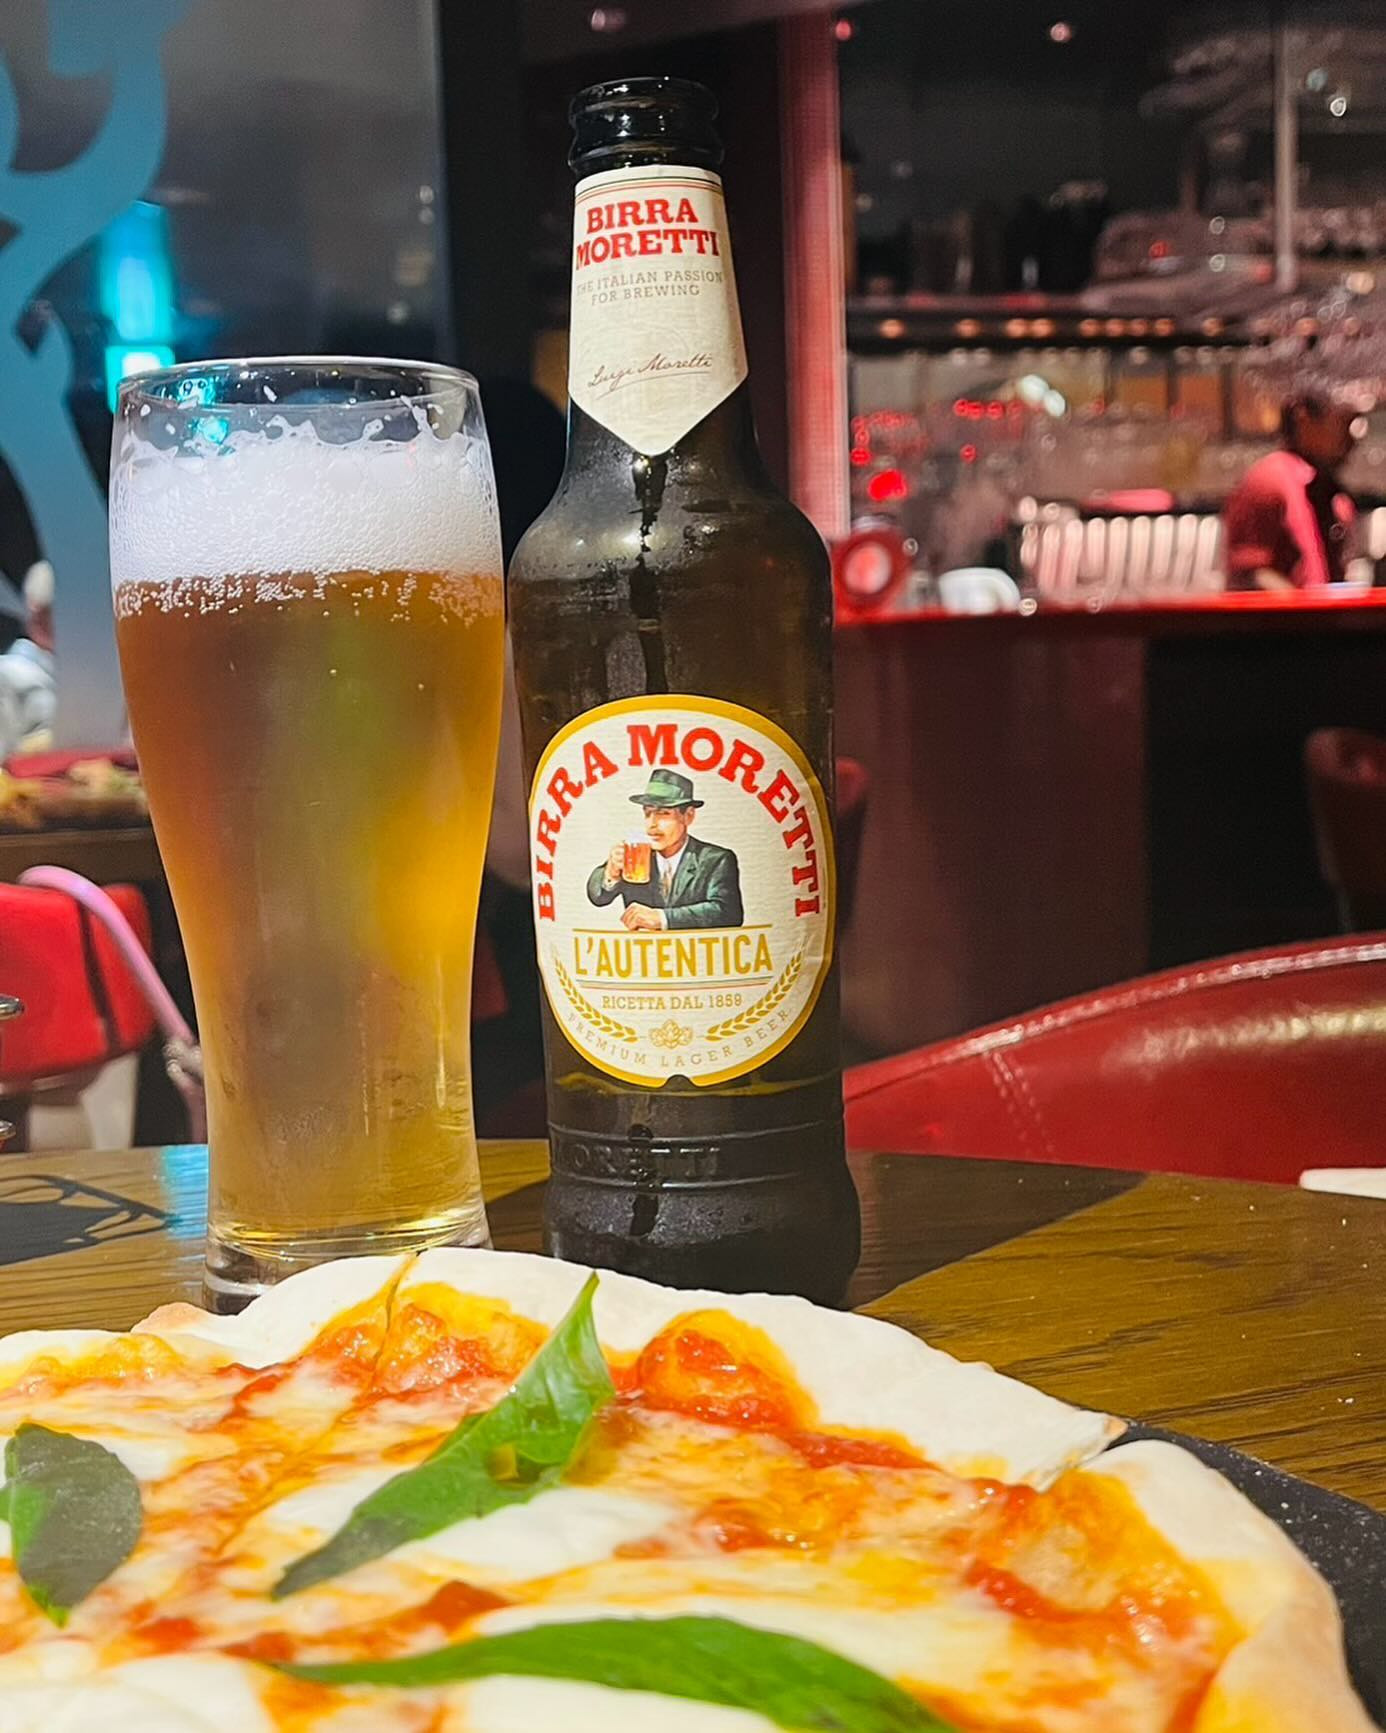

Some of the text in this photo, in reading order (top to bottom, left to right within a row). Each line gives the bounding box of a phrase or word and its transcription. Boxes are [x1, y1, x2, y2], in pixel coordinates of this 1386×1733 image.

[587, 198, 698, 234] BIRRA
[576, 229, 720, 271] MORETTI
[577, 270, 724, 296] THE ITALIAN PASSION
[591, 284, 700, 306] FOR BREWING
[537, 724, 820, 921] BIRRA MORETTI
[574, 933, 774, 979] L'AUTENTICA
[602, 993, 743, 1010] RICETTA DAL 1859
[567, 1009, 788, 1068] PREMIUM LAGER BEER
